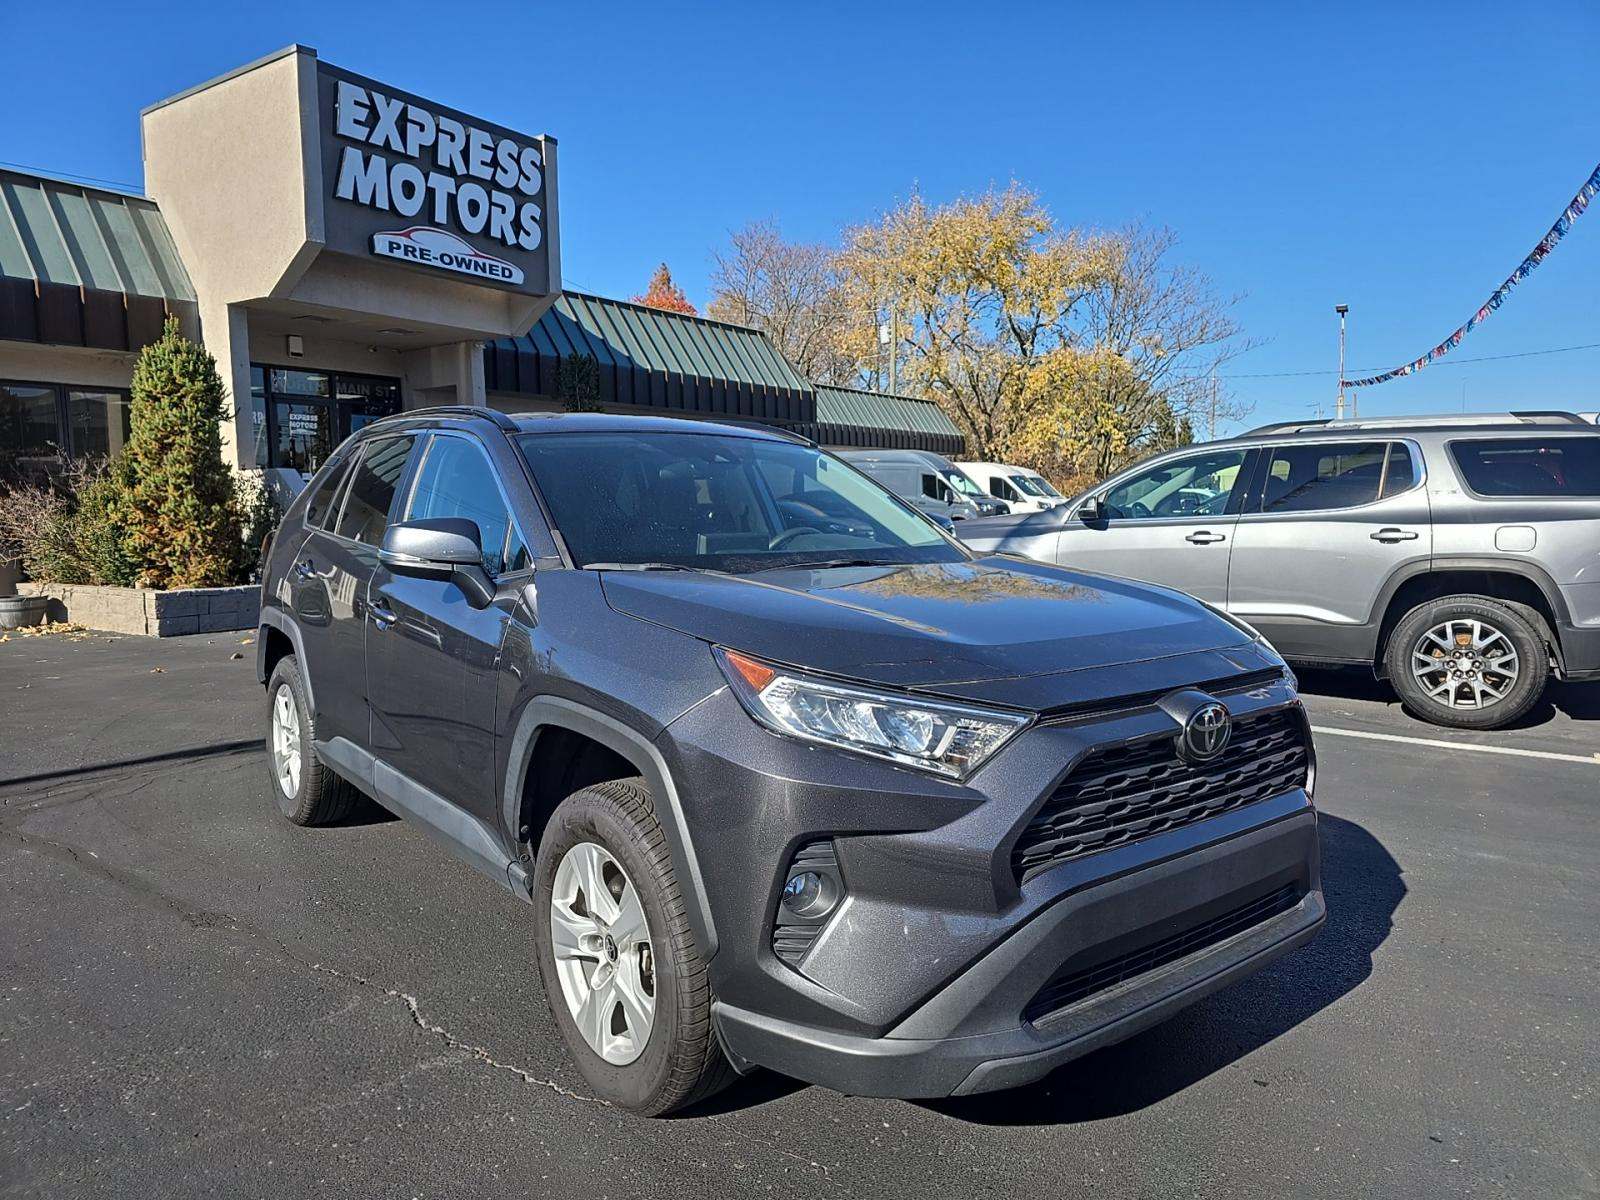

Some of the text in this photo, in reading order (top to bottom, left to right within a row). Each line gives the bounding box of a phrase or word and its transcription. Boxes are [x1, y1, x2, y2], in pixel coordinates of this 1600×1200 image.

[336, 80, 542, 196] EXPRESS
[335, 145, 542, 251] MOTORS
[388, 240, 513, 280] PRE-OWNED
[336, 382, 370, 396] MAIN
[289, 413, 319, 422] EXPRESS
[289, 420, 318, 430] MOTORS
